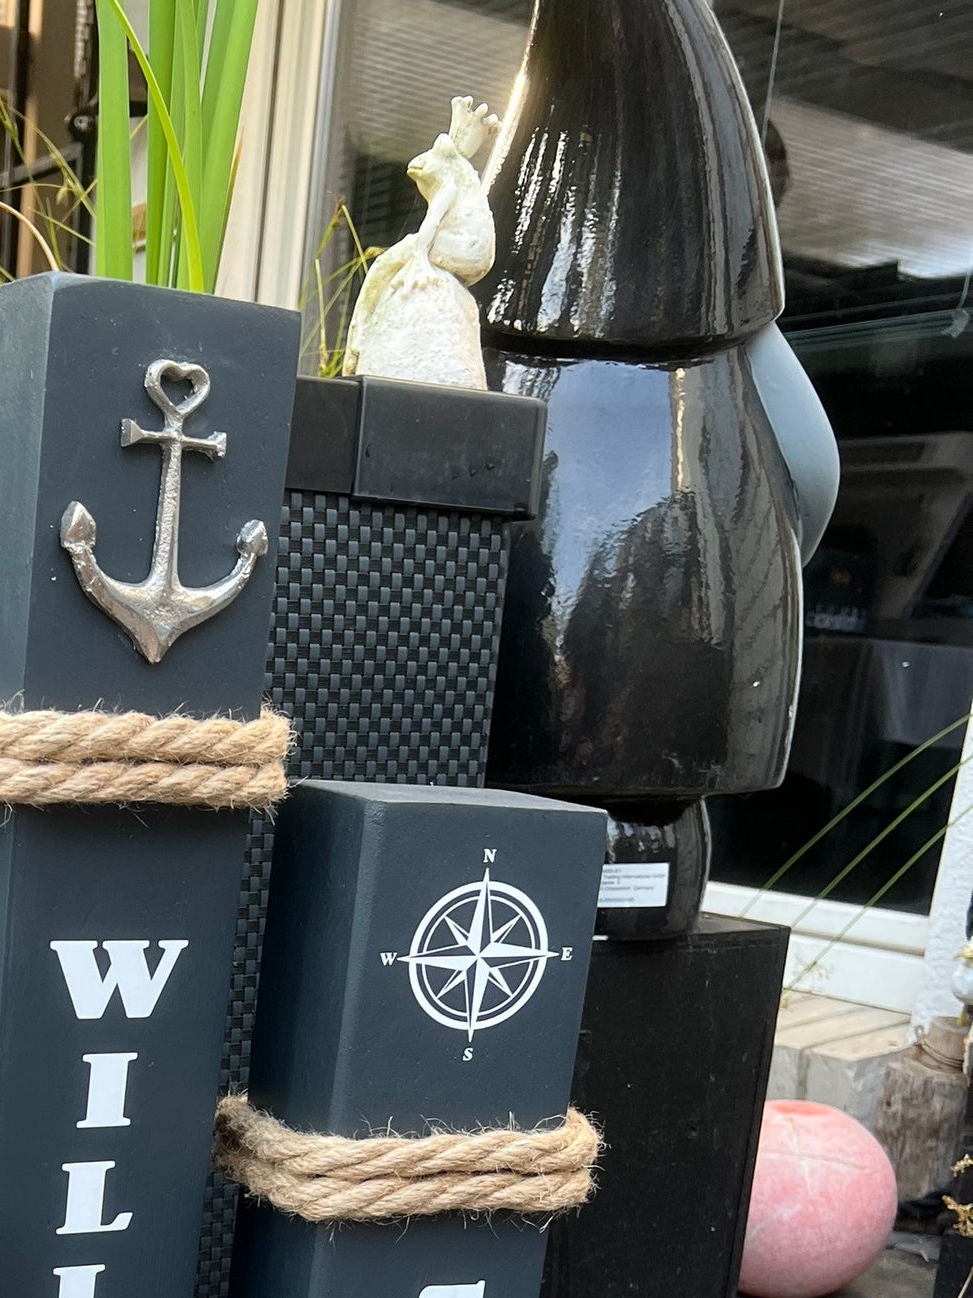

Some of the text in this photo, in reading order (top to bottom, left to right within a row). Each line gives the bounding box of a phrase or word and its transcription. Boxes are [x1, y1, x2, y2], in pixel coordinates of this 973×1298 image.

[483, 848, 498, 863] N
[379, 952, 398, 966] W
[560, 946, 573, 961] E
[462, 1047, 474, 1061] S
